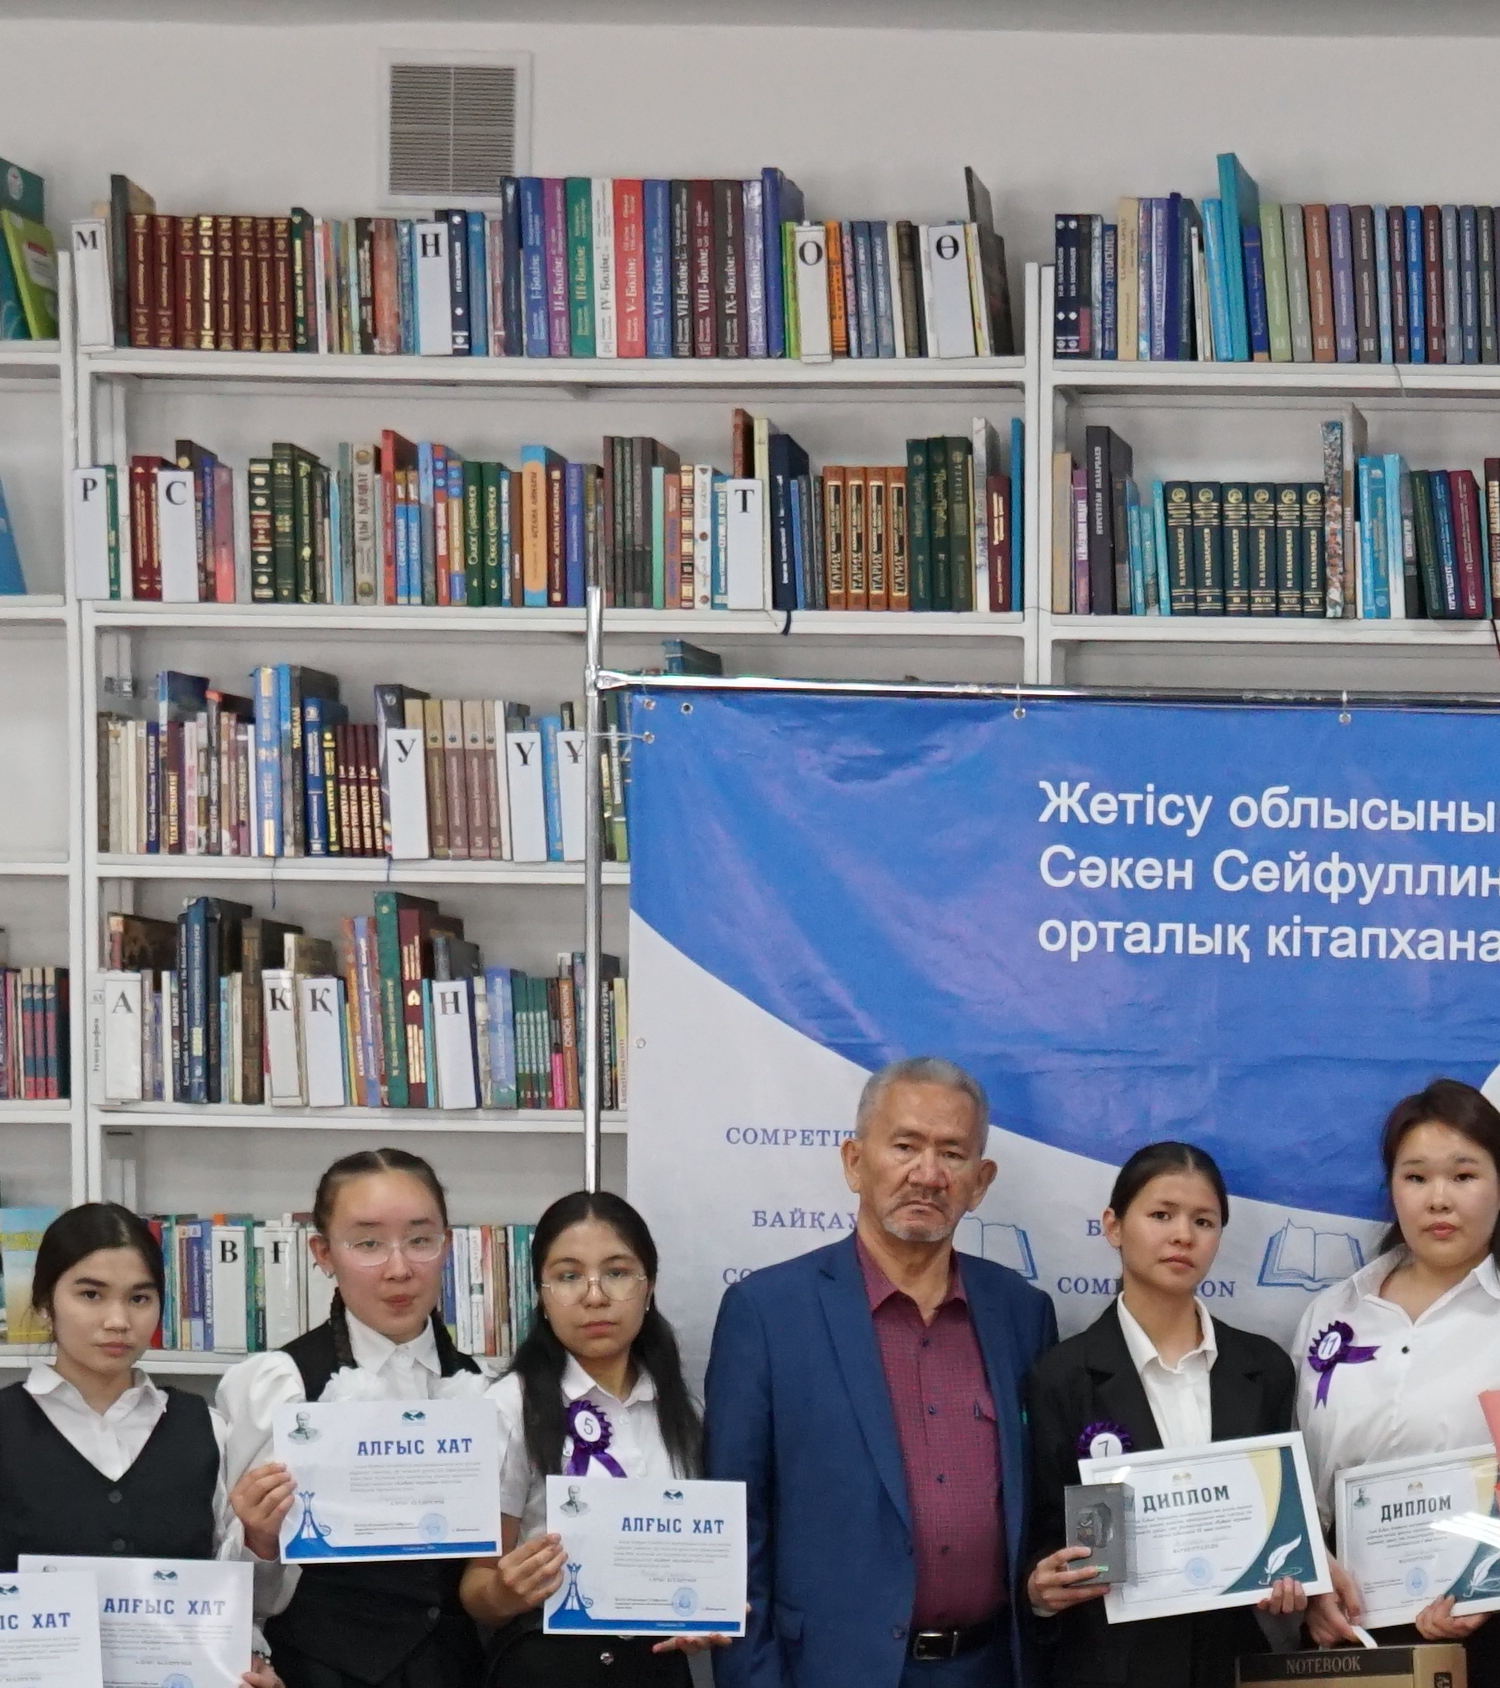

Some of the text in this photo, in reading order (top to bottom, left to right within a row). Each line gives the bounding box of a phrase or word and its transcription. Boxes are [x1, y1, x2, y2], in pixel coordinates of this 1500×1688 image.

[1038, 780, 1214, 836] Жетісу
[1039, 844, 1194, 890] Сәкен
[1038, 919, 1251, 964] орталық
[1319, 1336, 1337, 1356] 11
[582, 1417, 595, 1436] 5
[357, 1438, 473, 1457] АЛҒЫС ХАТ
[1097, 1440, 1111, 1457] 7
[1142, 1485, 1231, 1514] ДИПЛОМ
[1380, 1495, 1452, 1523] ДИПЛОМ
[621, 1517, 725, 1535] АЛҒЫС ХАТ
[102, 1597, 226, 1616] АЛҒЫС ХАТ
[32, 1612, 71, 1630] ХАТ
[1286, 1656, 1362, 1676] NOTEBOOK
